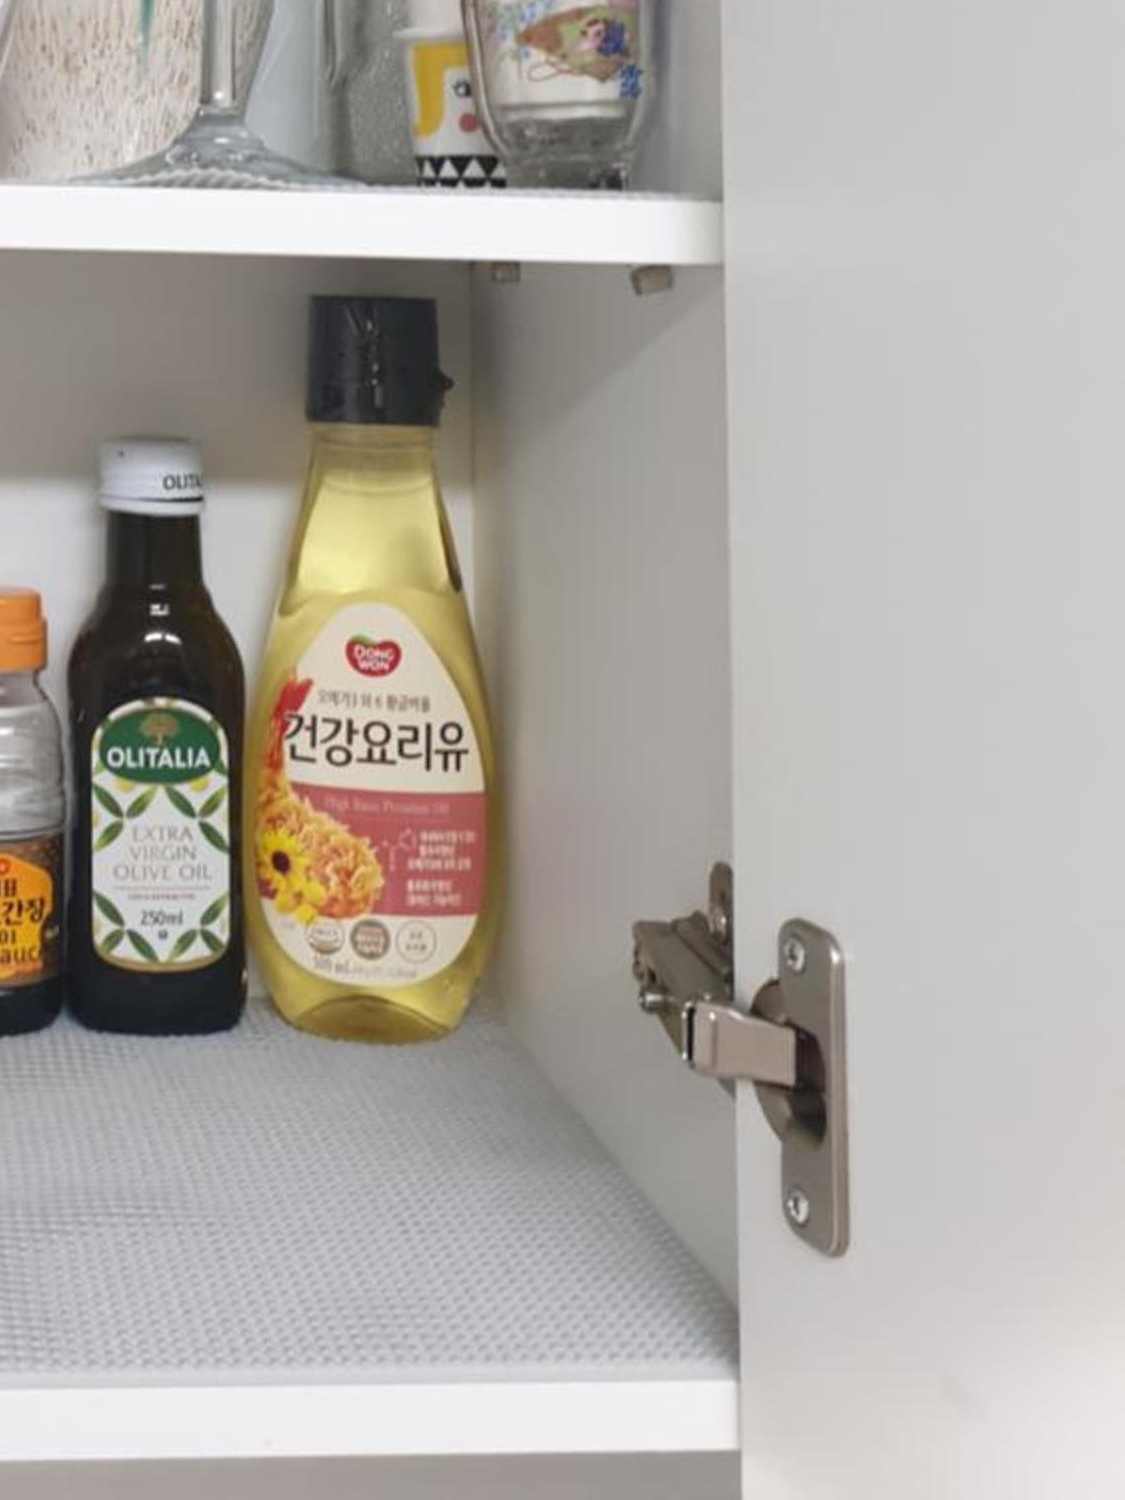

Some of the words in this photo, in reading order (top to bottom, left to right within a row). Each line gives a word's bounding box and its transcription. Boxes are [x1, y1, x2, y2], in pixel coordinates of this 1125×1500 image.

[354, 644, 395, 661] DONG
[358, 657, 390, 671] WON
[284, 713, 469, 773] 건강요리유
[106, 746, 212, 769] OLITALIA
[132, 825, 194, 842] EXTRA
[129, 845, 198, 861] VIRGIN
[113, 864, 171, 881] OLIVE
[178, 863, 213, 881] OIL
[140, 908, 184, 926] 250ml
